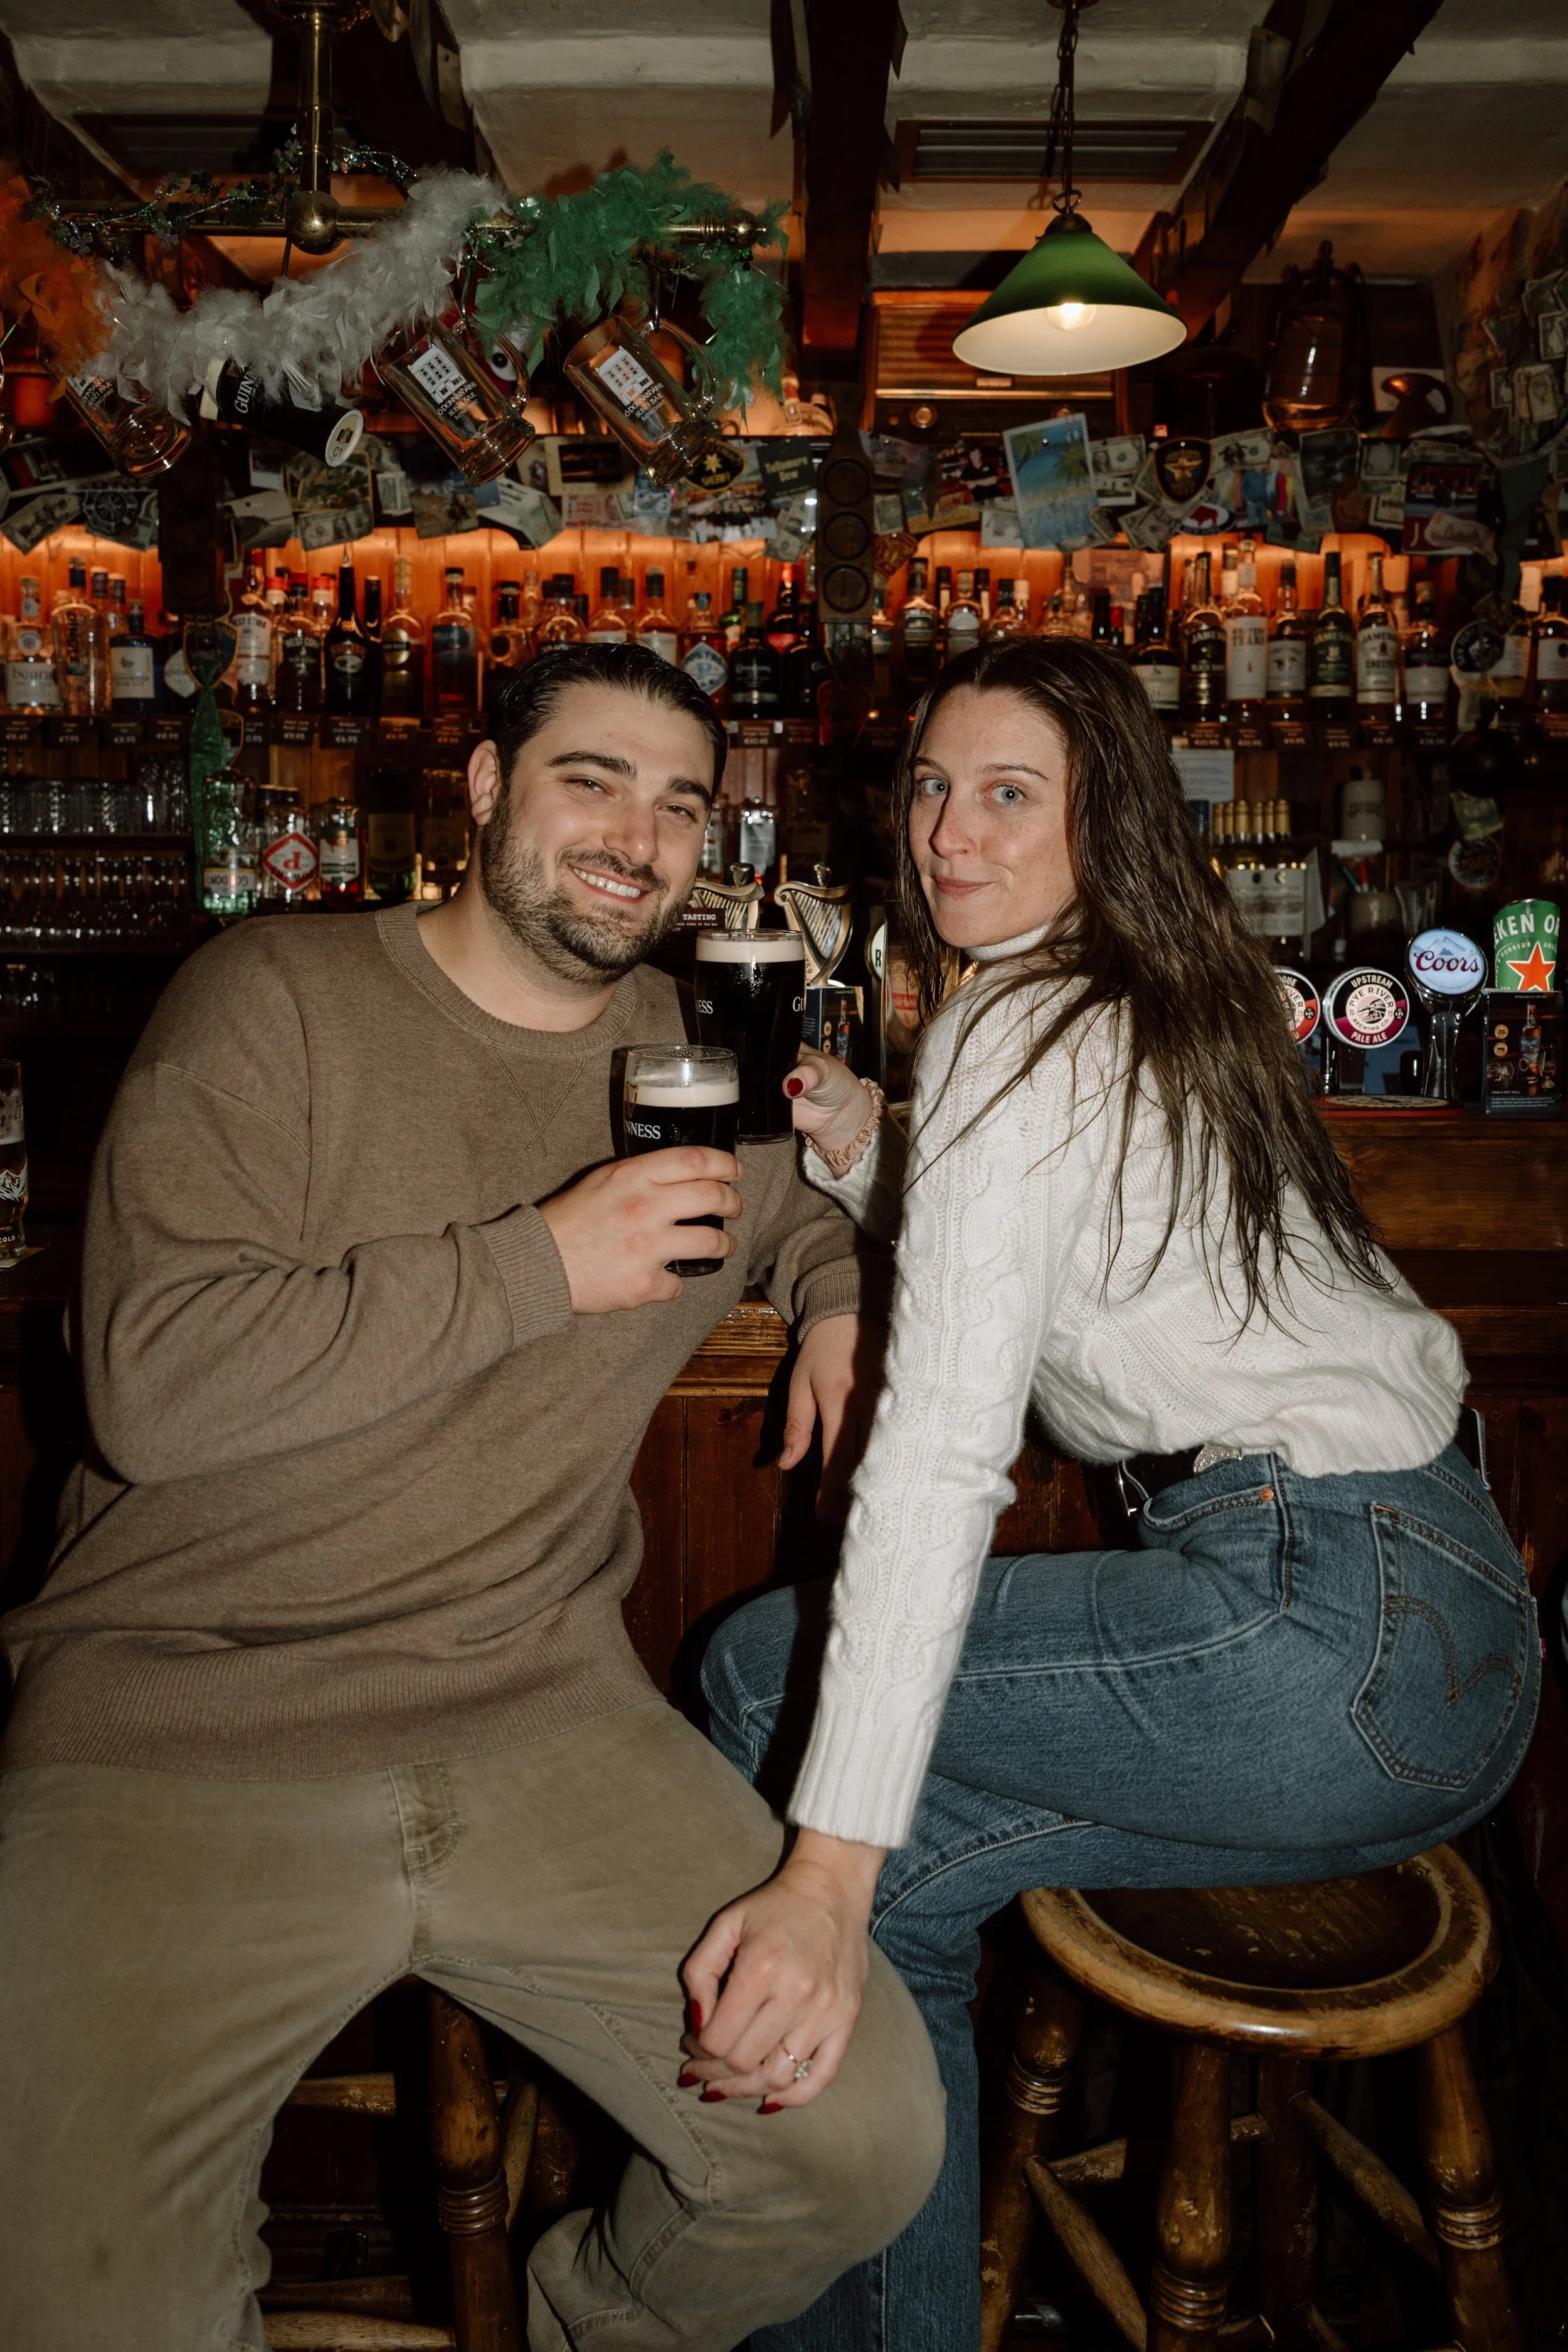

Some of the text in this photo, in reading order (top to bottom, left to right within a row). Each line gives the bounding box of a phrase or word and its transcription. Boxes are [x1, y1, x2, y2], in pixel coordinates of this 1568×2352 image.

[1494, 913, 1535, 945] EKEN
[1414, 951, 1480, 972] Coors
[1350, 974, 1393, 989] UPSTREAM
[1349, 987, 1394, 1008] RYE RIVER
[1352, 1018, 1379, 1030] BREWING
[1350, 1031, 1387, 1044] PALE ALE
[625, 1120, 661, 1140] NNESS
